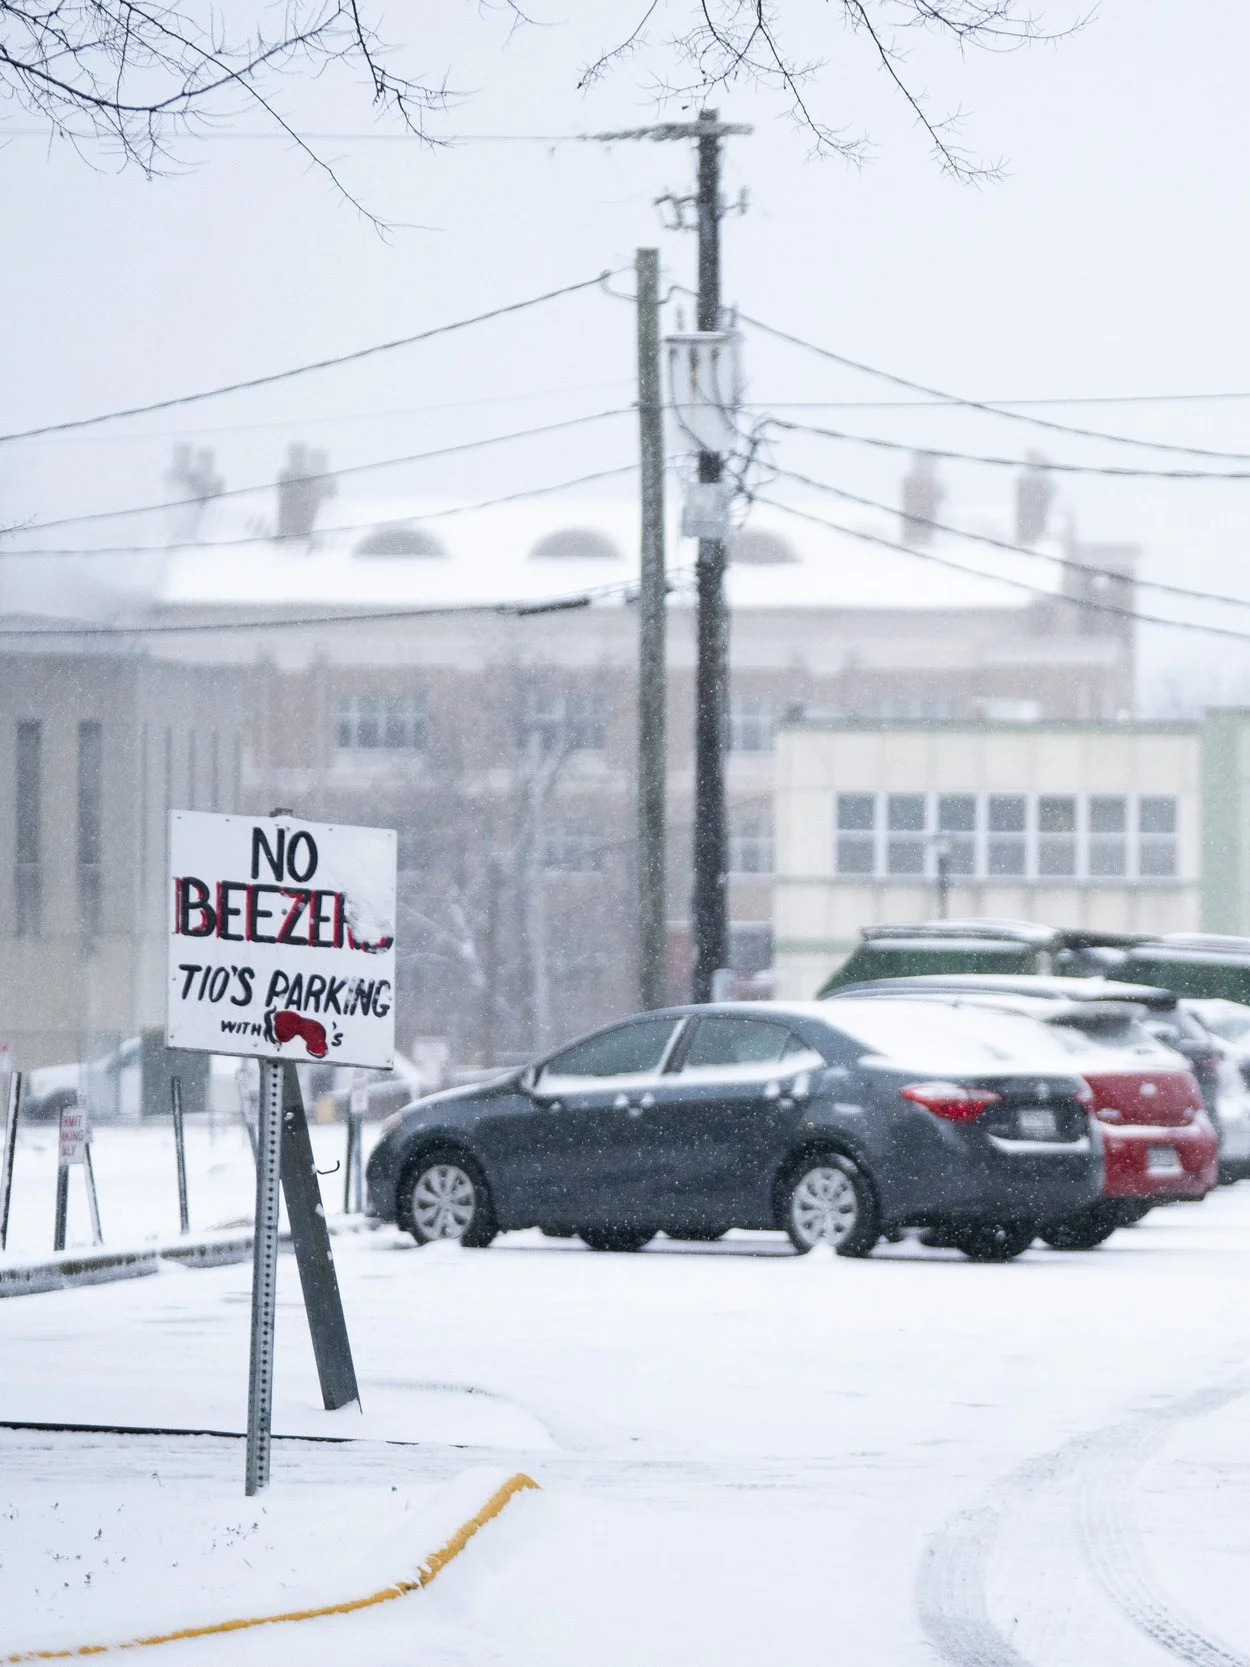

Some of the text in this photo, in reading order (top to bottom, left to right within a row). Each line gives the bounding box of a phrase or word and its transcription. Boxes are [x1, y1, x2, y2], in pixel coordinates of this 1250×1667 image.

[251, 826, 318, 883] NO
[178, 963, 392, 1018] TIO'S PARKING
[220, 1020, 262, 1037] WITH
